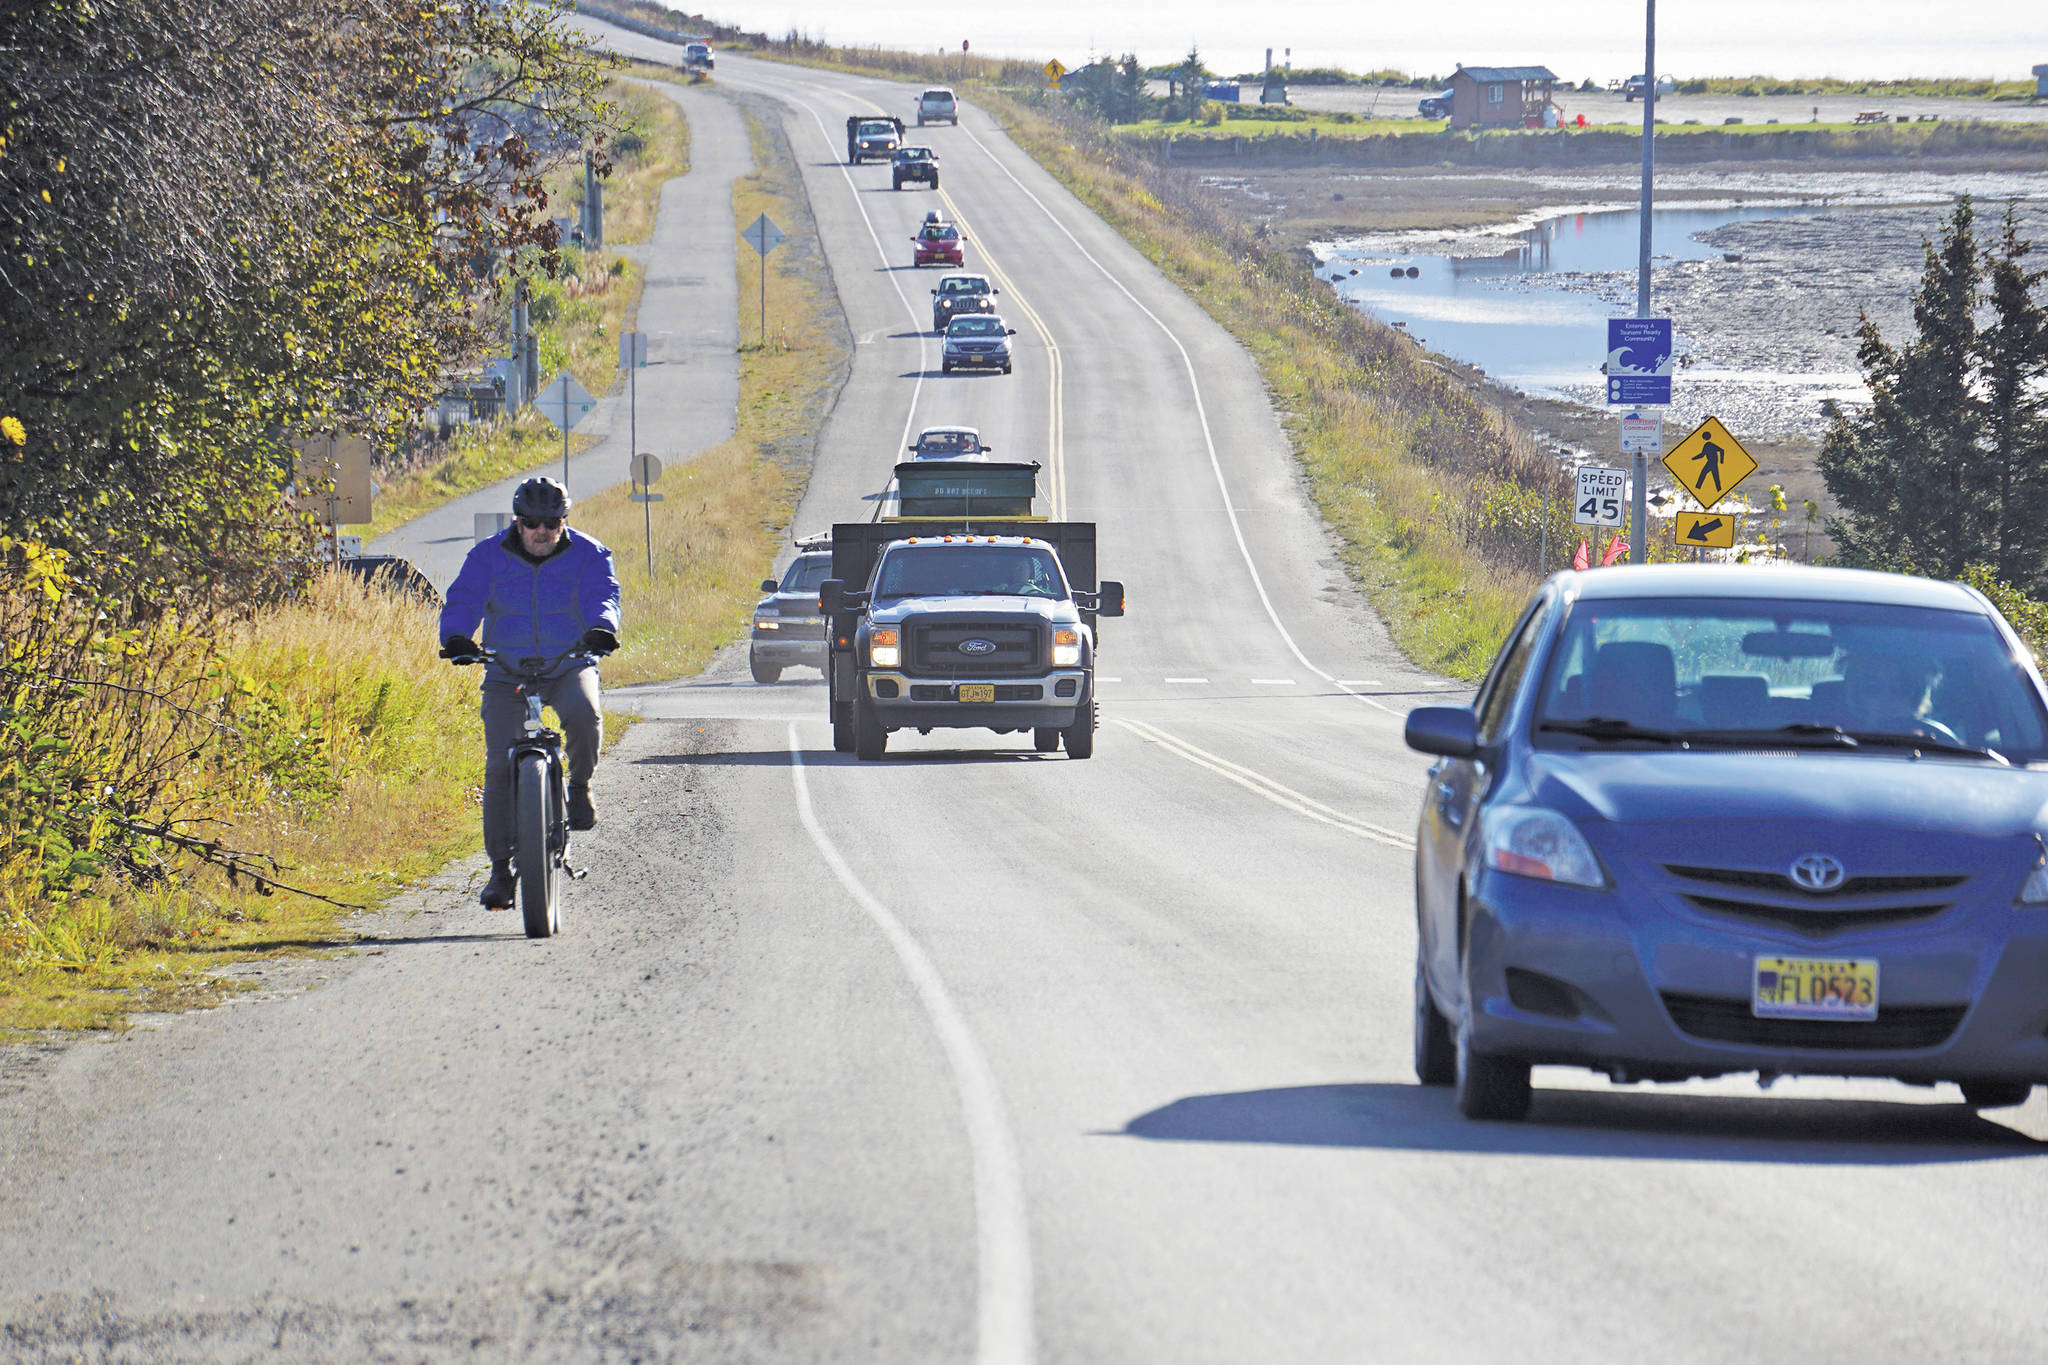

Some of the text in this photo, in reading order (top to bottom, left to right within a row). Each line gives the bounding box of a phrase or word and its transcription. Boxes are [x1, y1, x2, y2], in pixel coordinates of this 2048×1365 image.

[1581, 474, 1622, 485] SPEED
[1584, 486, 1617, 496] LIMIT
[1579, 497, 1619, 520] 45
[966, 642, 988, 651] Ford
[1780, 975, 1873, 1007] FLD523
